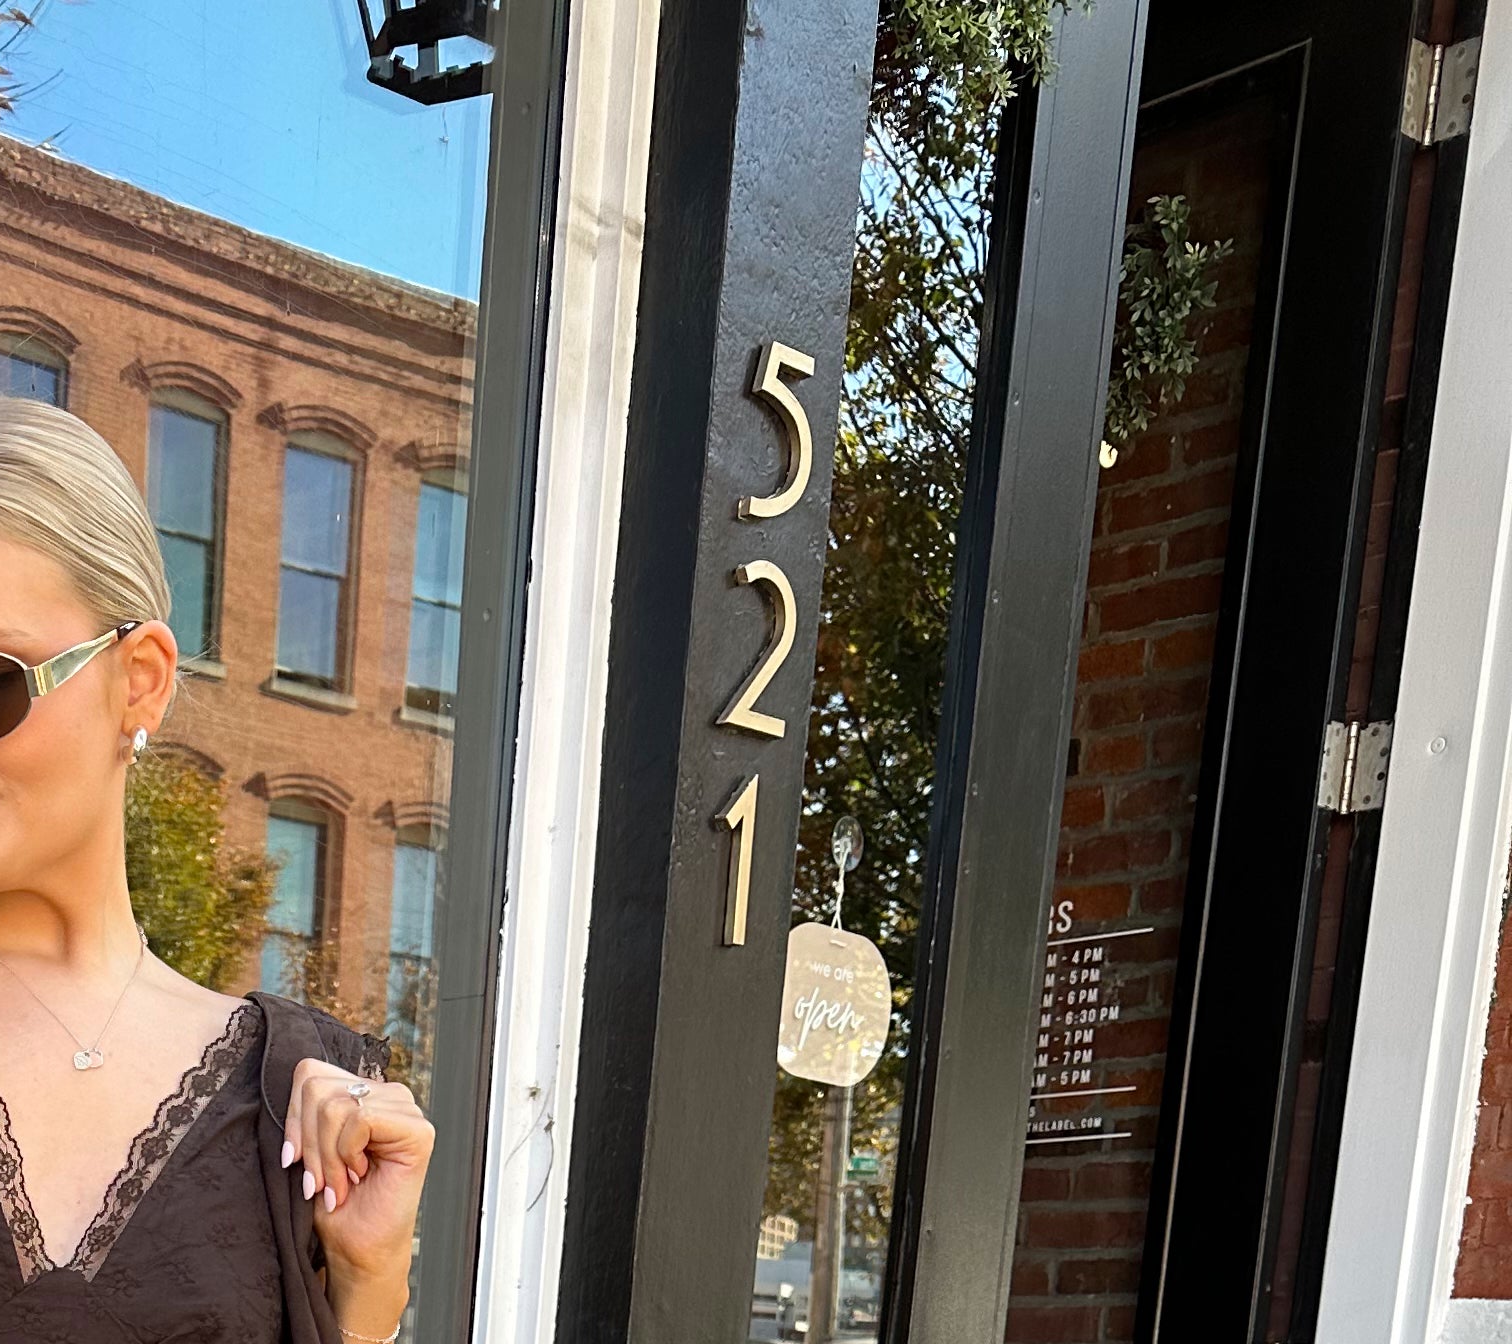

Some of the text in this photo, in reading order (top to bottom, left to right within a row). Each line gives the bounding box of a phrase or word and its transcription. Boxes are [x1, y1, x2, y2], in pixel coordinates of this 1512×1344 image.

[715, 341, 814, 946] 521
[1072, 950, 1080, 964] 4
[1084, 947, 1103, 962] PM
[813, 961, 854, 984] we are
[1070, 970, 1078, 985] 5
[1081, 968, 1100, 983] PM
[1068, 990, 1076, 1005] 6
[1079, 988, 1098, 1003] PM
[794, 986, 865, 1051] open
[1065, 1008, 1096, 1025] 6:30
[1100, 1005, 1119, 1021] PM
[1064, 1031, 1071, 1046] 7
[1074, 1029, 1093, 1044] PM
[1063, 1051, 1070, 1065] 7
[1073, 1049, 1092, 1064] PM
[1060, 1071, 1068, 1085] 5
[1072, 1069, 1090, 1084] PM
